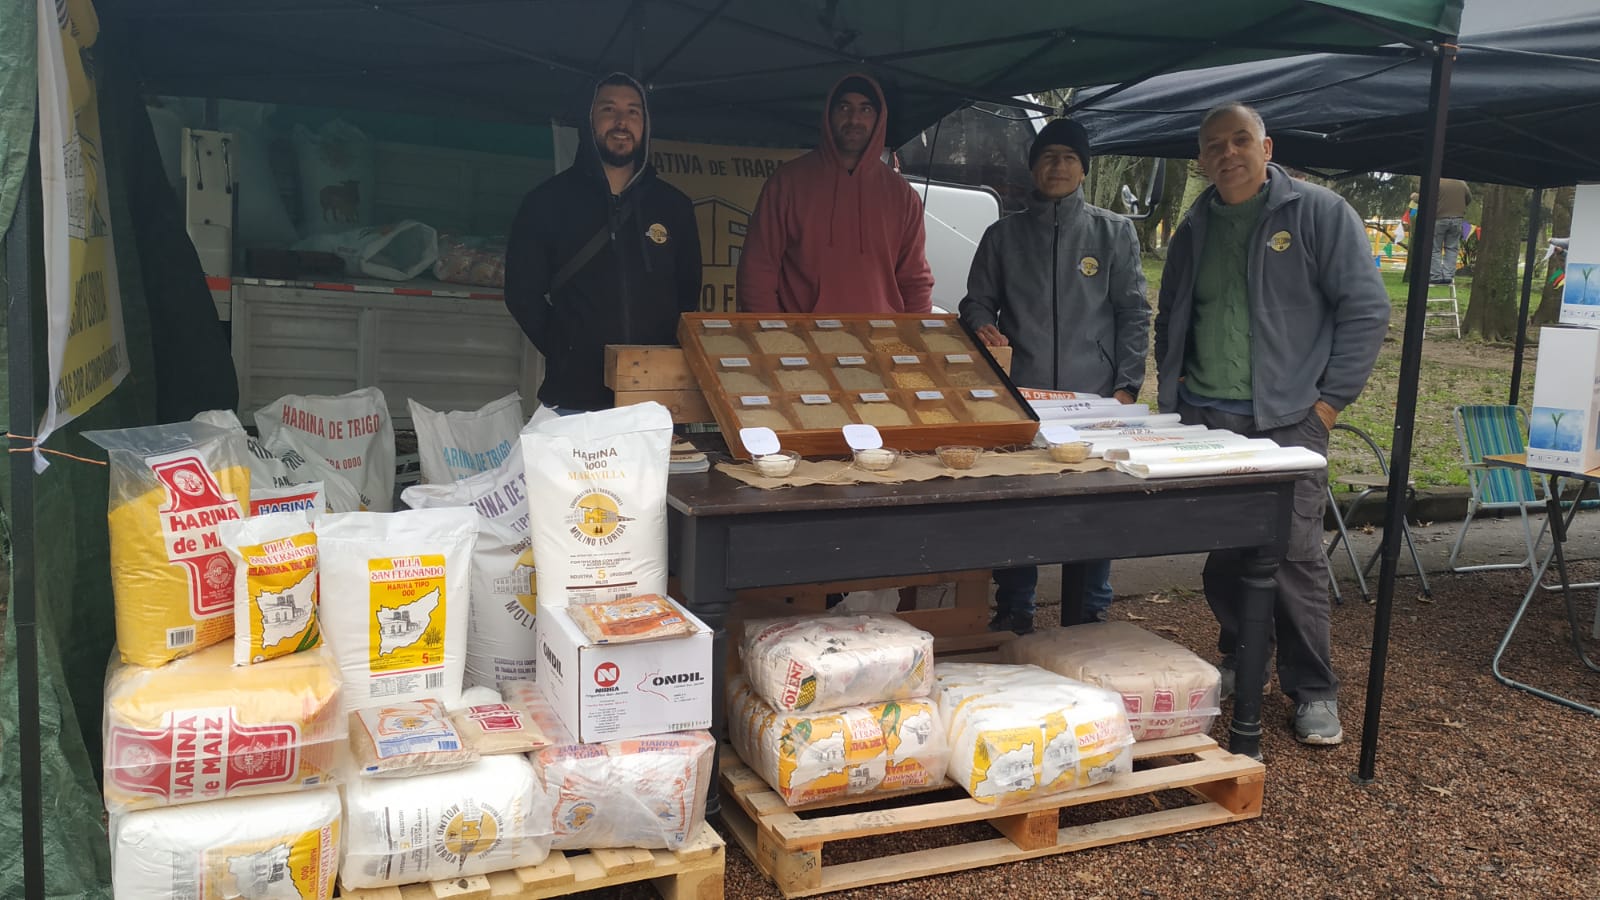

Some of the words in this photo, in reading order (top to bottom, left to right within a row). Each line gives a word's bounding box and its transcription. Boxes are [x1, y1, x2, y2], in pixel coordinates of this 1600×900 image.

[652, 151, 703, 175] ATIVA
[708, 159, 727, 176] DE
[1050, 393, 1073, 401] MAIZ
[282, 404, 325, 438] HARINA
[328, 421, 344, 440] DE
[347, 413, 380, 438] TRIGO
[572, 447, 618, 461] HARINA
[567, 471, 625, 480] MARAVILLA
[504, 479, 525, 506] DE
[518, 473, 527, 487] T
[169, 506, 240, 533] HARINA
[569, 526, 597, 546] MOLINO
[599, 524, 627, 546] FLORIDA
[173, 537, 197, 555] de
[264, 539, 294, 554] VILLA
[393, 558, 420, 568] VILLA
[371, 571, 390, 581] SAN
[391, 567, 444, 579] FERNANDO
[597, 569, 606, 579] 5
[387, 583, 413, 591] HARINA
[504, 600, 537, 633] MOLI
[422, 653, 429, 664] 5
[543, 641, 563, 678] ONDIL
[652, 672, 704, 686] ONDIL
[201, 716, 224, 775] MAIZ
[173, 715, 197, 799] HARINA
[200, 780, 220, 797] de
[436, 804, 461, 836] MOLINO
